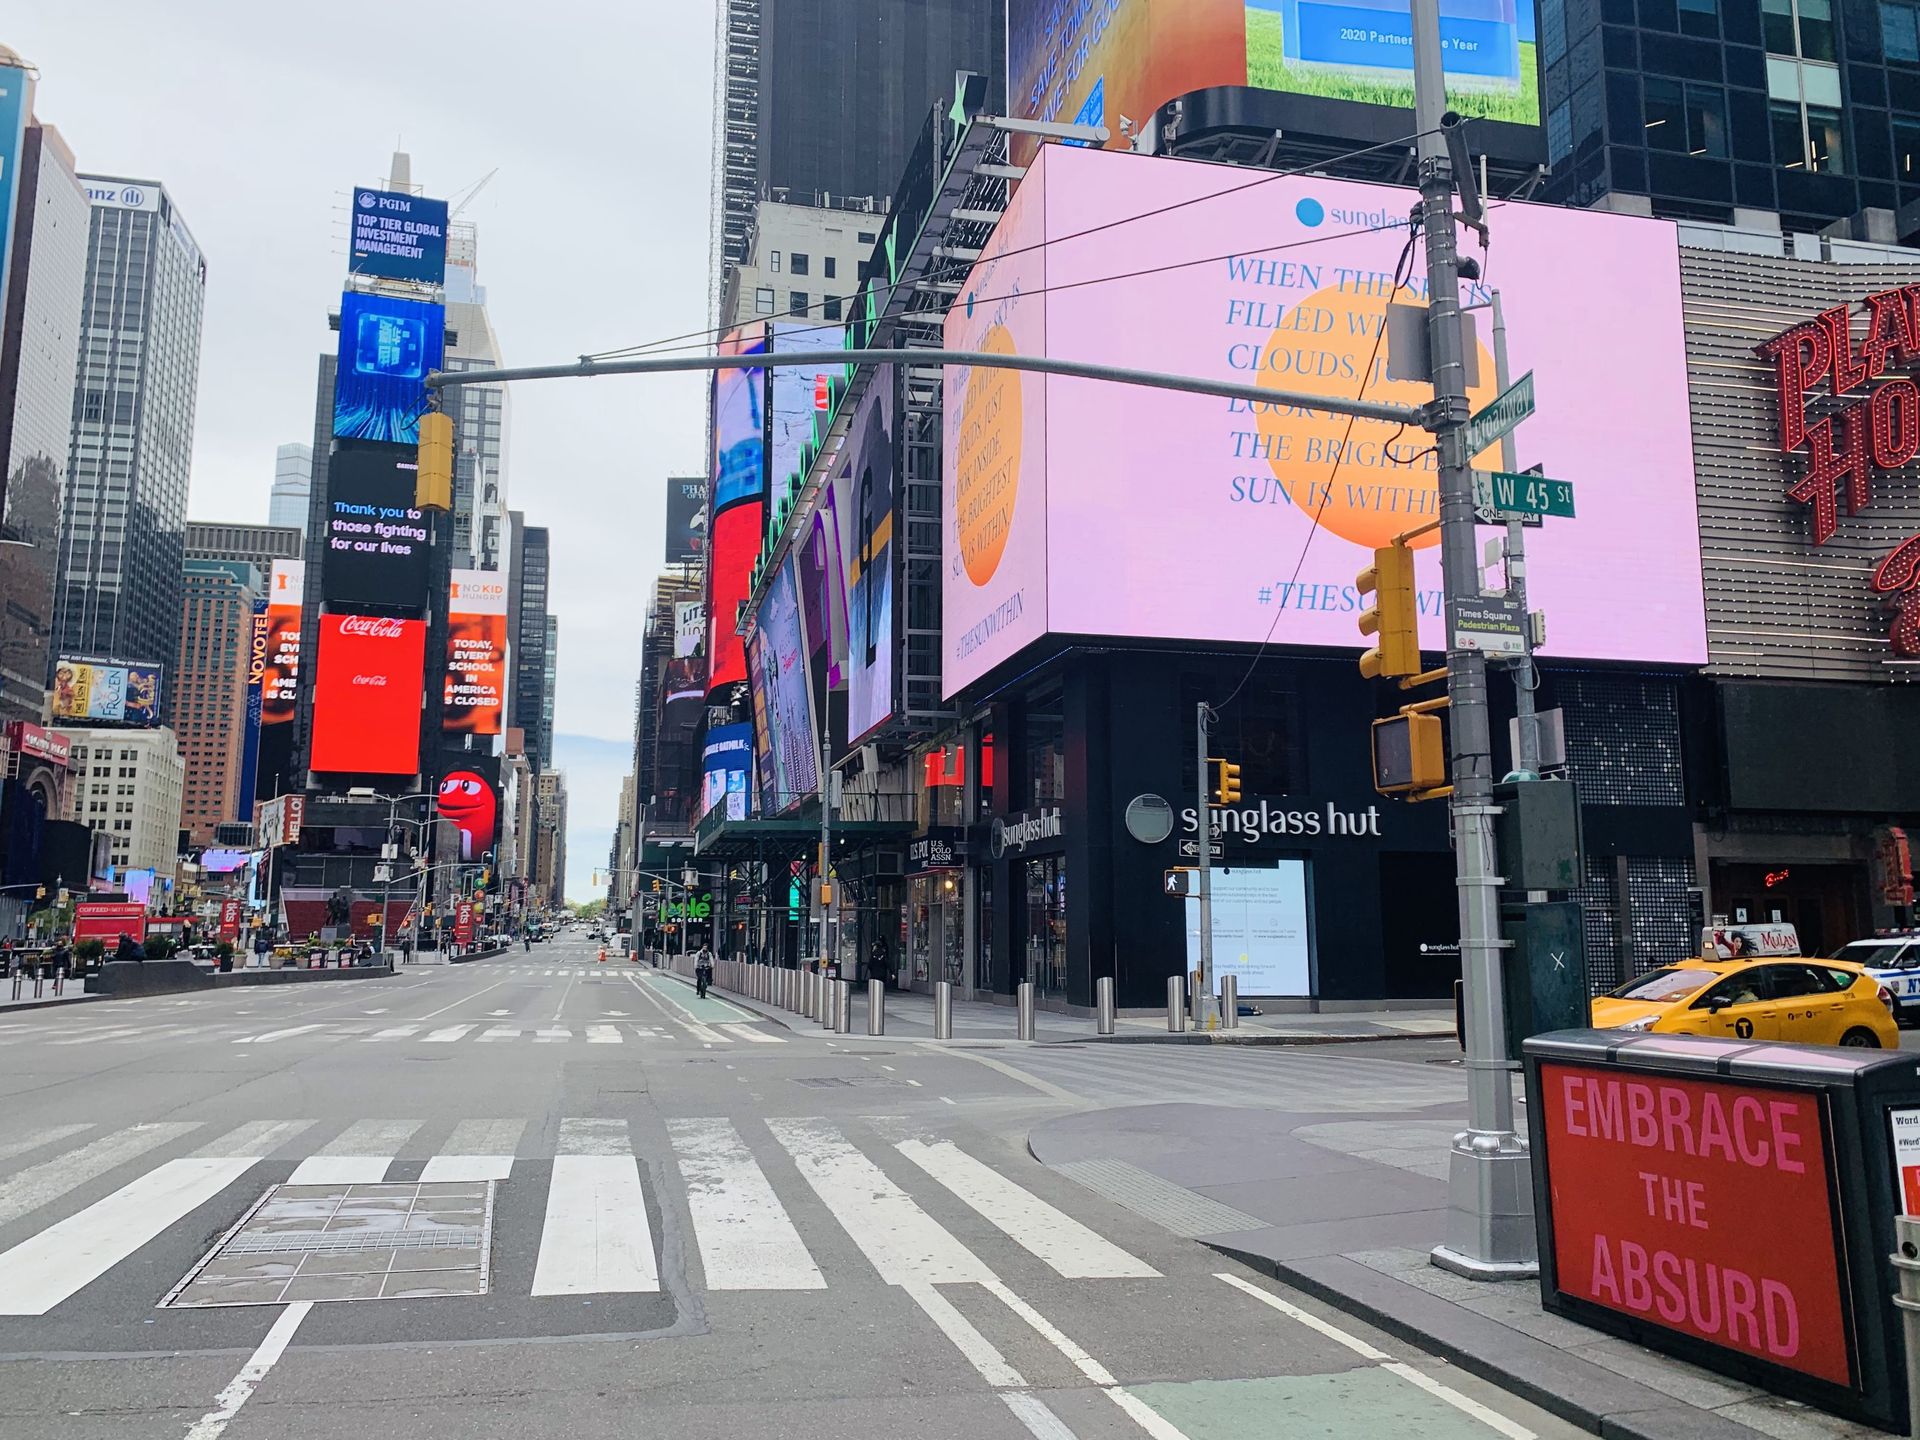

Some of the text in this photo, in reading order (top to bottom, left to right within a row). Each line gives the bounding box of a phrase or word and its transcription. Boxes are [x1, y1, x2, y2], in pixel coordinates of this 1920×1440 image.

[1340, 28, 1366, 41] 2020
[1452, 38, 1478, 51] Year
[1066, 33, 1090, 95] FOR
[1031, 48, 1058, 115] SAVE
[378, 197, 411, 213] PGIM
[357, 213, 442, 237] TOP TIER GLOBAL
[1331, 207, 1418, 234] sunglas
[356, 226, 418, 246] INVESTMENT
[355, 238, 424, 259] MANAGEMENT
[1227, 255, 1323, 290] WHEN
[1333, 267, 1395, 298] THE
[1225, 299, 1335, 334] FILLED
[1227, 343, 1361, 383] CLOUDS,
[1474, 383, 1531, 449] Broadway
[1230, 431, 1438, 473] THE BRIGHTE
[967, 456, 1014, 527] BRIGHTEST
[1230, 475, 1439, 515] SUN IS WITHI
[1496, 477, 1571, 511] W 45 St
[333, 501, 422, 520] Thank you to
[1482, 507, 1536, 521] ONE AY
[331, 520, 427, 541] those fighting
[330, 537, 412, 556] for our lives
[463, 583, 504, 594] NO KID
[1457, 607, 1513, 622] Times Square
[1458, 619, 1521, 633] Pedestrian Plaza
[339, 614, 405, 639] Coca-Cola
[249, 608, 268, 684] NOVOTEL
[453, 638, 494, 651] TODAY,
[454, 651, 491, 660] EVERY
[448, 661, 496, 672] SCHOOL
[444, 684, 497, 695] AMERICA
[465, 674, 478, 683] IN
[102, 670, 121, 717] FROZEN
[454, 696, 499, 707] CLOSED
[1003, 807, 1062, 852] sunglass hut
[1326, 800, 1382, 837] hut
[930, 840, 945, 848] U.S.
[225, 902, 235, 923] tkts
[460, 904, 471, 925] tkts
[660, 892, 712, 923] pelé
[1760, 931, 1798, 950] MULAN
[1562, 1076, 1806, 1175] EMBRACE
[1895, 1115, 1919, 1126] Word
[1638, 1171, 1709, 1230] THE
[1591, 1234, 1800, 1358] ABSURD
